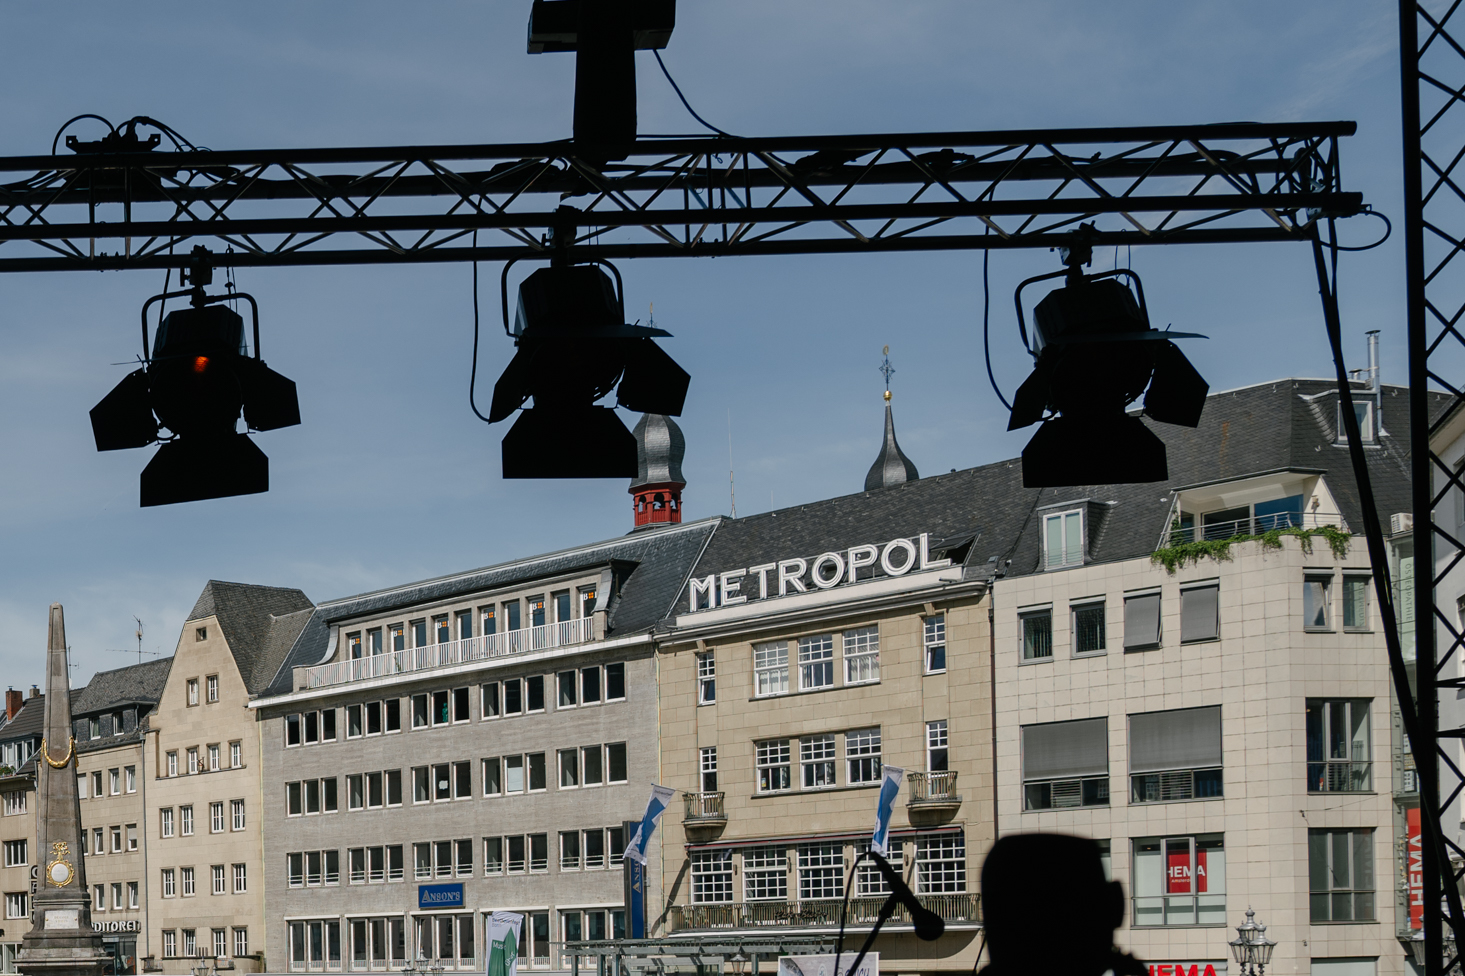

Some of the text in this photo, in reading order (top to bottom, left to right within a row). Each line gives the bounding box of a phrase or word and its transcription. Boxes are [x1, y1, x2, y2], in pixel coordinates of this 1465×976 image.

[689, 532, 953, 613] METROPOL
[1405, 563, 1414, 621] OSTEOPATHIE
[1167, 865, 1206, 878] HEMA
[421, 889, 461, 903] ANSON'S
[91, 920, 137, 933] DITOREI
